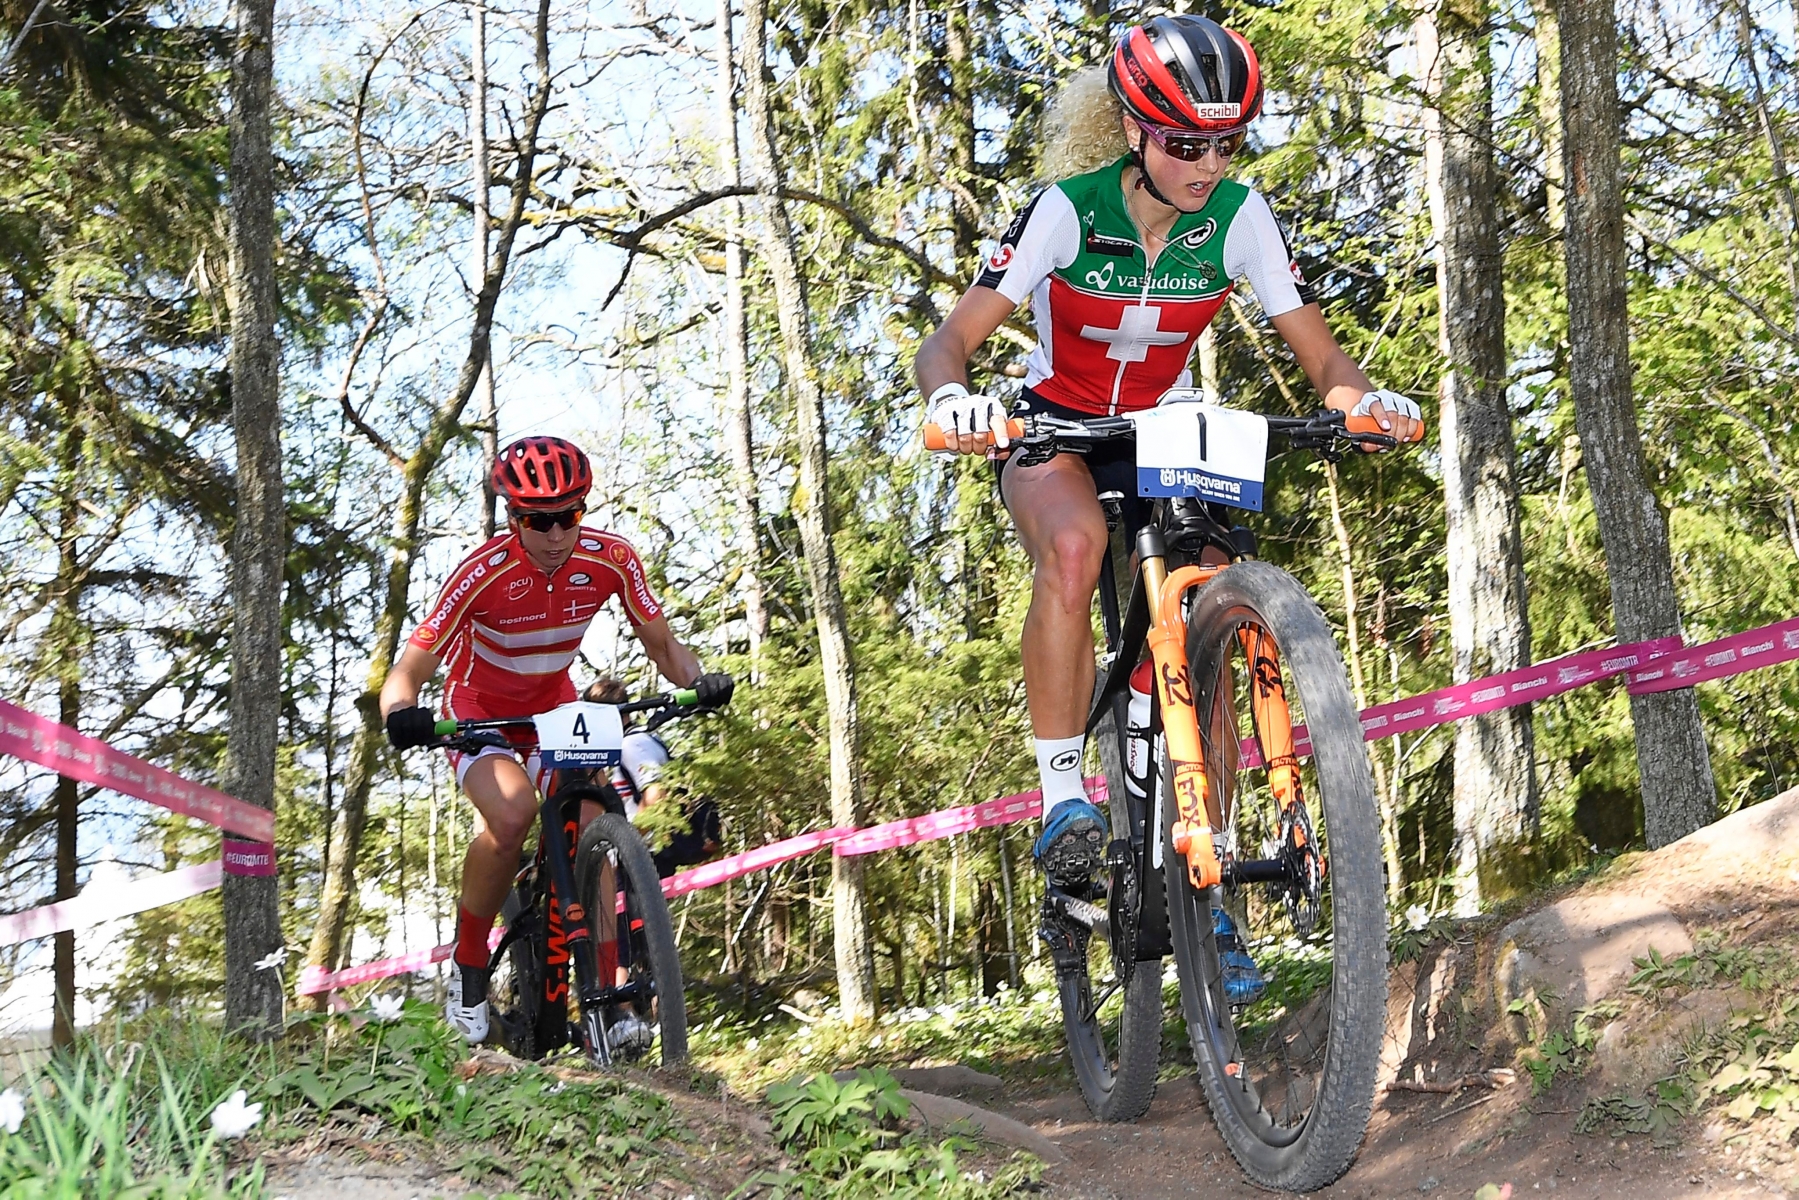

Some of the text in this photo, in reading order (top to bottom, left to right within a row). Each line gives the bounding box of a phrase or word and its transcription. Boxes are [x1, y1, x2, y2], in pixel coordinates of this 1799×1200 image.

[1196, 412, 1207, 462] 1
[1176, 470, 1241, 494] Husqvarna
[429, 564, 486, 630] postnord
[627, 559, 659, 615] postnord
[499, 612, 547, 625] postnord
[1741, 640, 1775, 657] Bianchi
[1636, 669, 1664, 682] Bianchi
[1393, 707, 1425, 722] Bianchi
[1511, 676, 1547, 693] Bianchi
[572, 712, 591, 744] 4
[563, 751, 609, 761] Husqvarna
[1177, 776, 1201, 828] FOX
[226, 851, 269, 867] #EUROMTB
